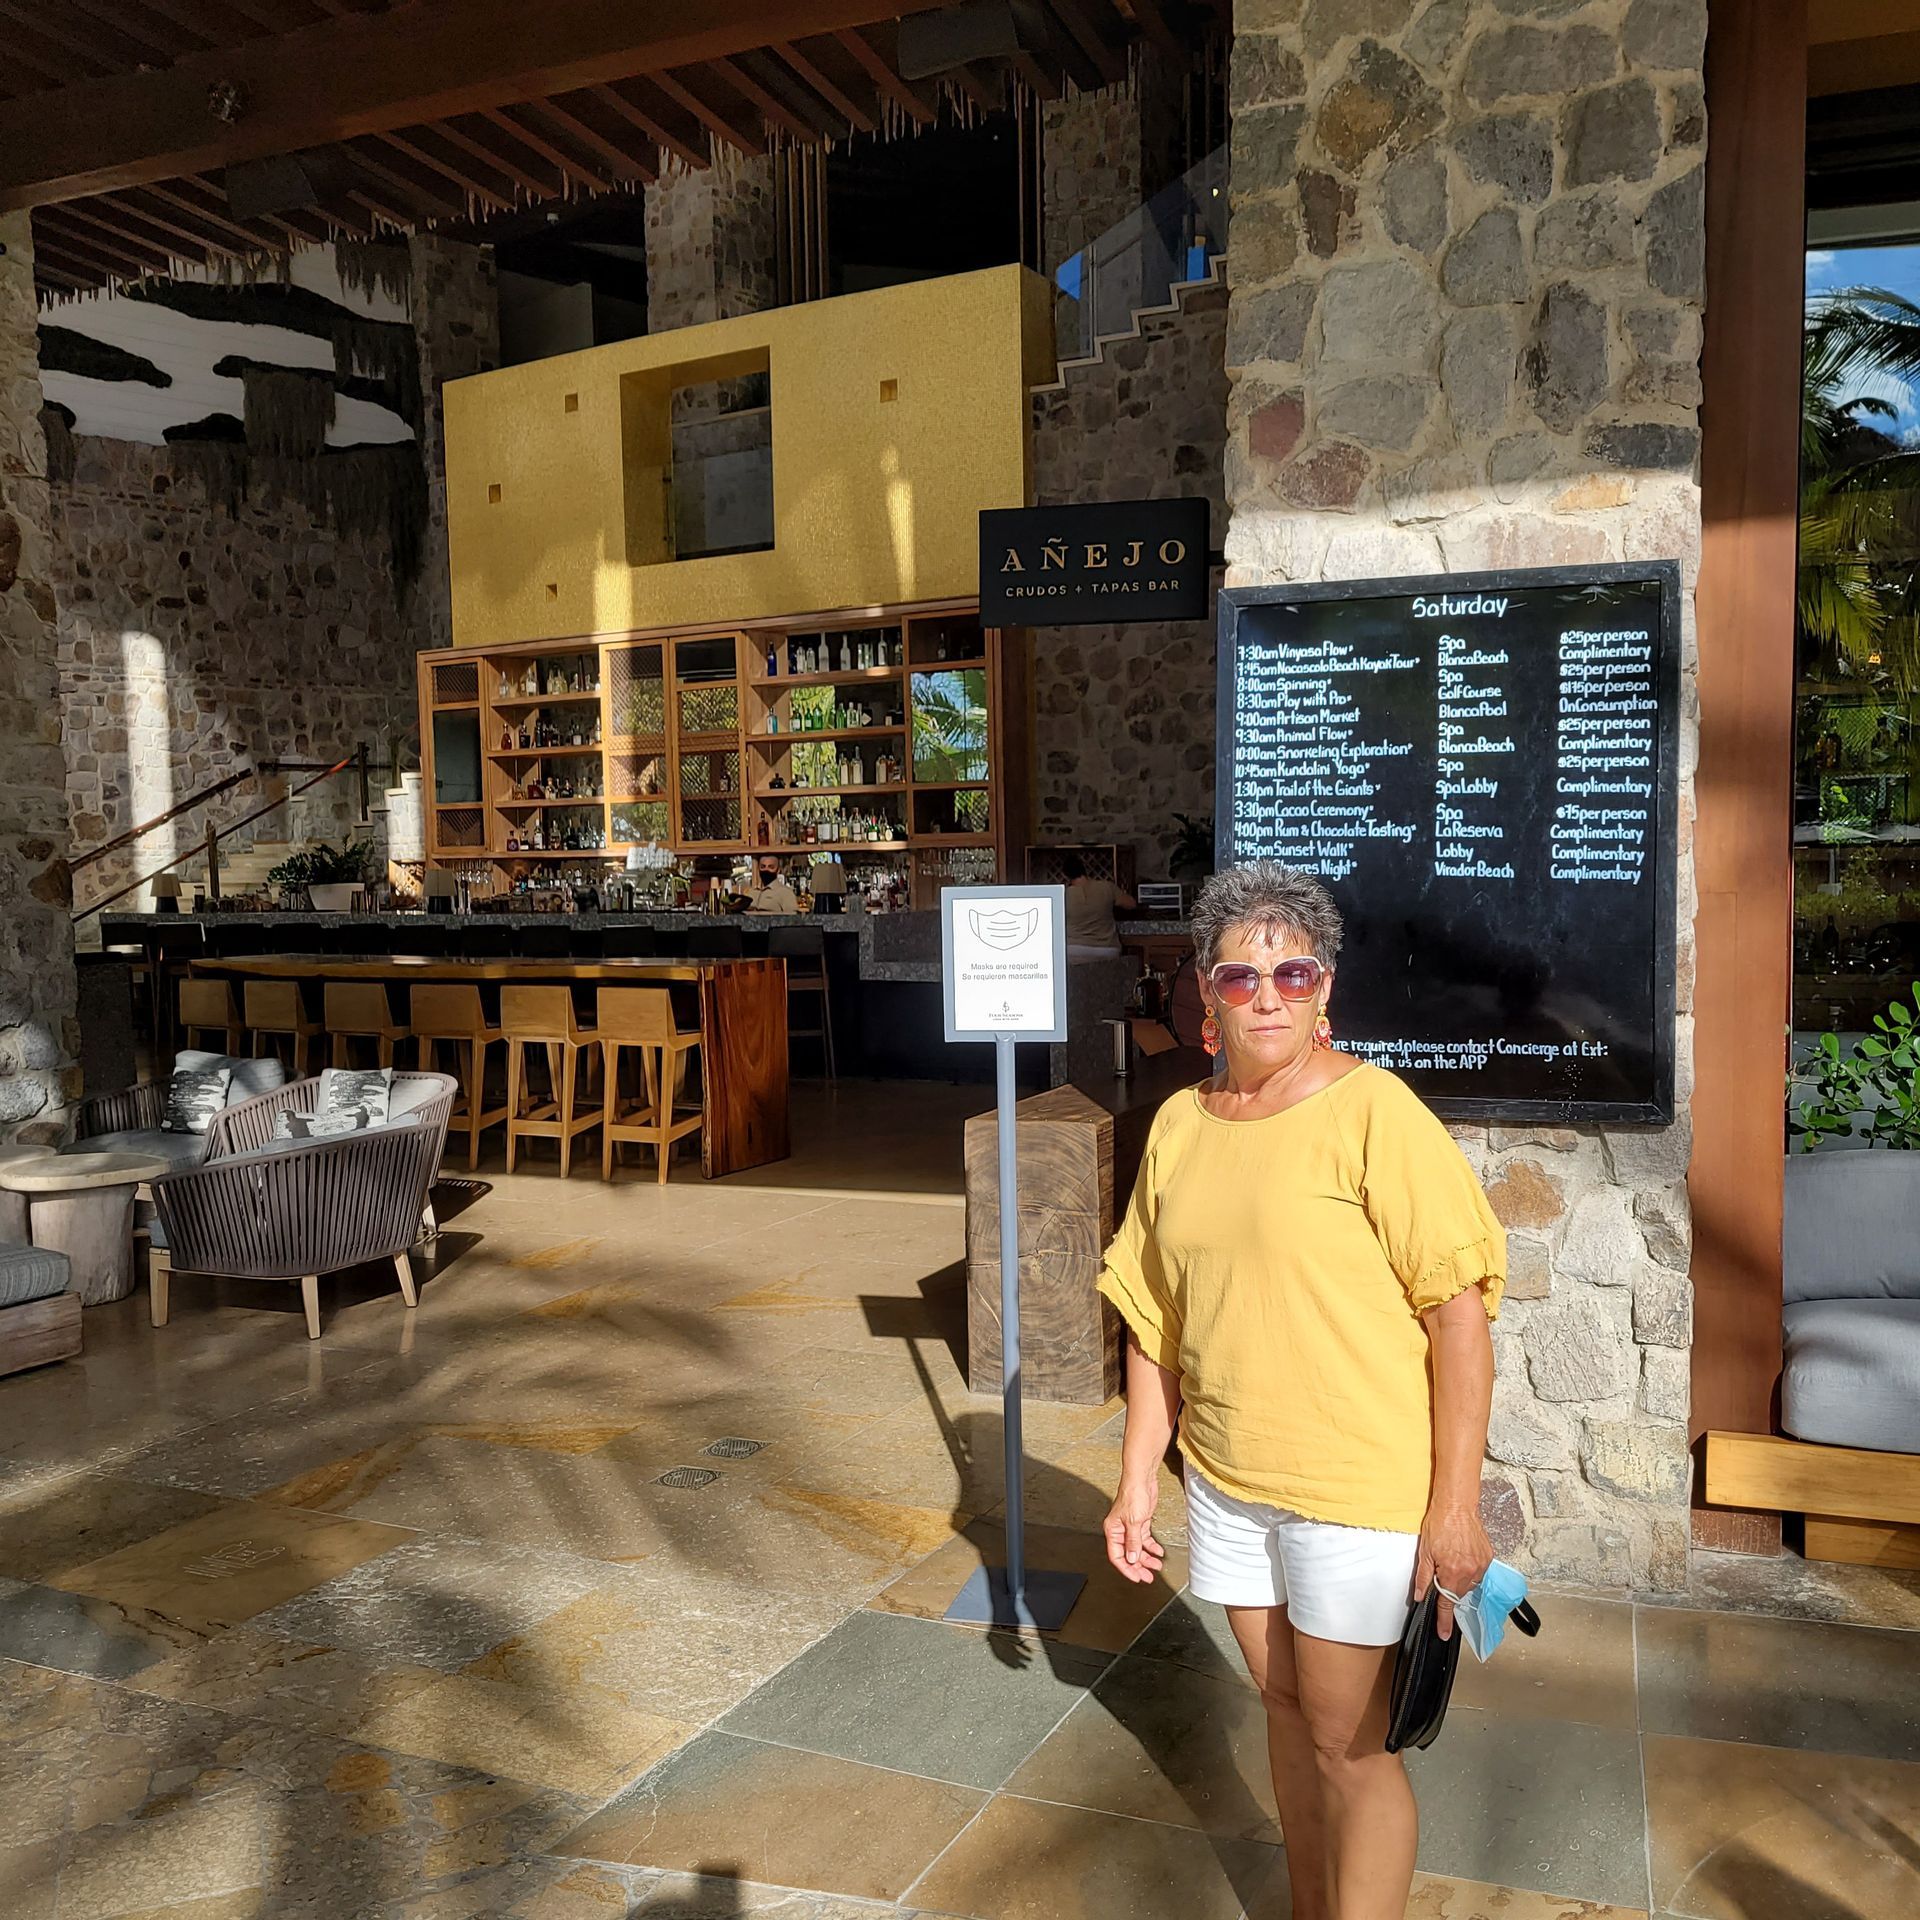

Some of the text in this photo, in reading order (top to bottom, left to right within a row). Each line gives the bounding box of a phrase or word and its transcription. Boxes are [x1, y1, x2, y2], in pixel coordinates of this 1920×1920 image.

[1001, 537, 1186, 572] AÑEJO
[1006, 580, 1180, 597] CRUDOS + TAPAS BAR
[1412, 595, 1508, 618] Saturday
[1439, 635, 1466, 654] Spa
[1603, 630, 1648, 648] person
[1279, 643, 1322, 661] Vinyasa
[1474, 650, 1508, 665] Beach
[1559, 644, 1650, 663] Complimentary
[1329, 658, 1359, 671] Beach
[1361, 657, 1391, 673] Kayak
[1606, 663, 1650, 680] person
[1439, 669, 1463, 687] Spa
[1462, 686, 1502, 698] Course
[1604, 682, 1649, 696] person
[1277, 692, 1300, 710] Play
[1303, 692, 1327, 706] with
[1479, 701, 1507, 717] Pool
[1575, 694, 1657, 714] Consumption
[1277, 710, 1318, 725] Artisan
[1320, 707, 1360, 722] Market
[1277, 727, 1315, 741] Animal
[1439, 723, 1464, 740] Spa
[1600, 720, 1650, 735] person
[1478, 736, 1515, 753] Beach
[1558, 733, 1652, 753] Complimentary
[1277, 744, 1340, 763] Snorkeling
[1278, 761, 1330, 776] Kundalini
[1438, 758, 1464, 778] Spa
[1604, 755, 1649, 772] person
[1273, 779, 1298, 796] Trail
[1298, 781, 1311, 795] of
[1312, 779, 1333, 796] the
[1436, 778, 1497, 799] Spa Lobby
[1556, 776, 1650, 798] Complimentary
[1275, 800, 1309, 816] Cacao
[1436, 803, 1463, 825] Spa
[1602, 806, 1647, 824] person
[1275, 818, 1299, 837] Rum
[1301, 825, 1309, 836] &
[1311, 820, 1366, 837] Chocolate
[1436, 822, 1503, 838] La Reserva
[1551, 824, 1643, 844] Complimentary
[1274, 840, 1315, 856] Sunset
[1436, 841, 1473, 862] Lobby
[1552, 844, 1644, 865] Complimentary
[1435, 860, 1514, 879] Virador Beach
[1551, 864, 1641, 885] Complimentary
[1447, 1038, 1495, 1054] contact
[1497, 1039, 1560, 1062] Concierge
[1562, 1040, 1578, 1056] at
[1398, 1058, 1412, 1068] us
[1414, 1058, 1432, 1069] on
[1434, 1055, 1457, 1069] the
[1459, 1055, 1487, 1070] APP
